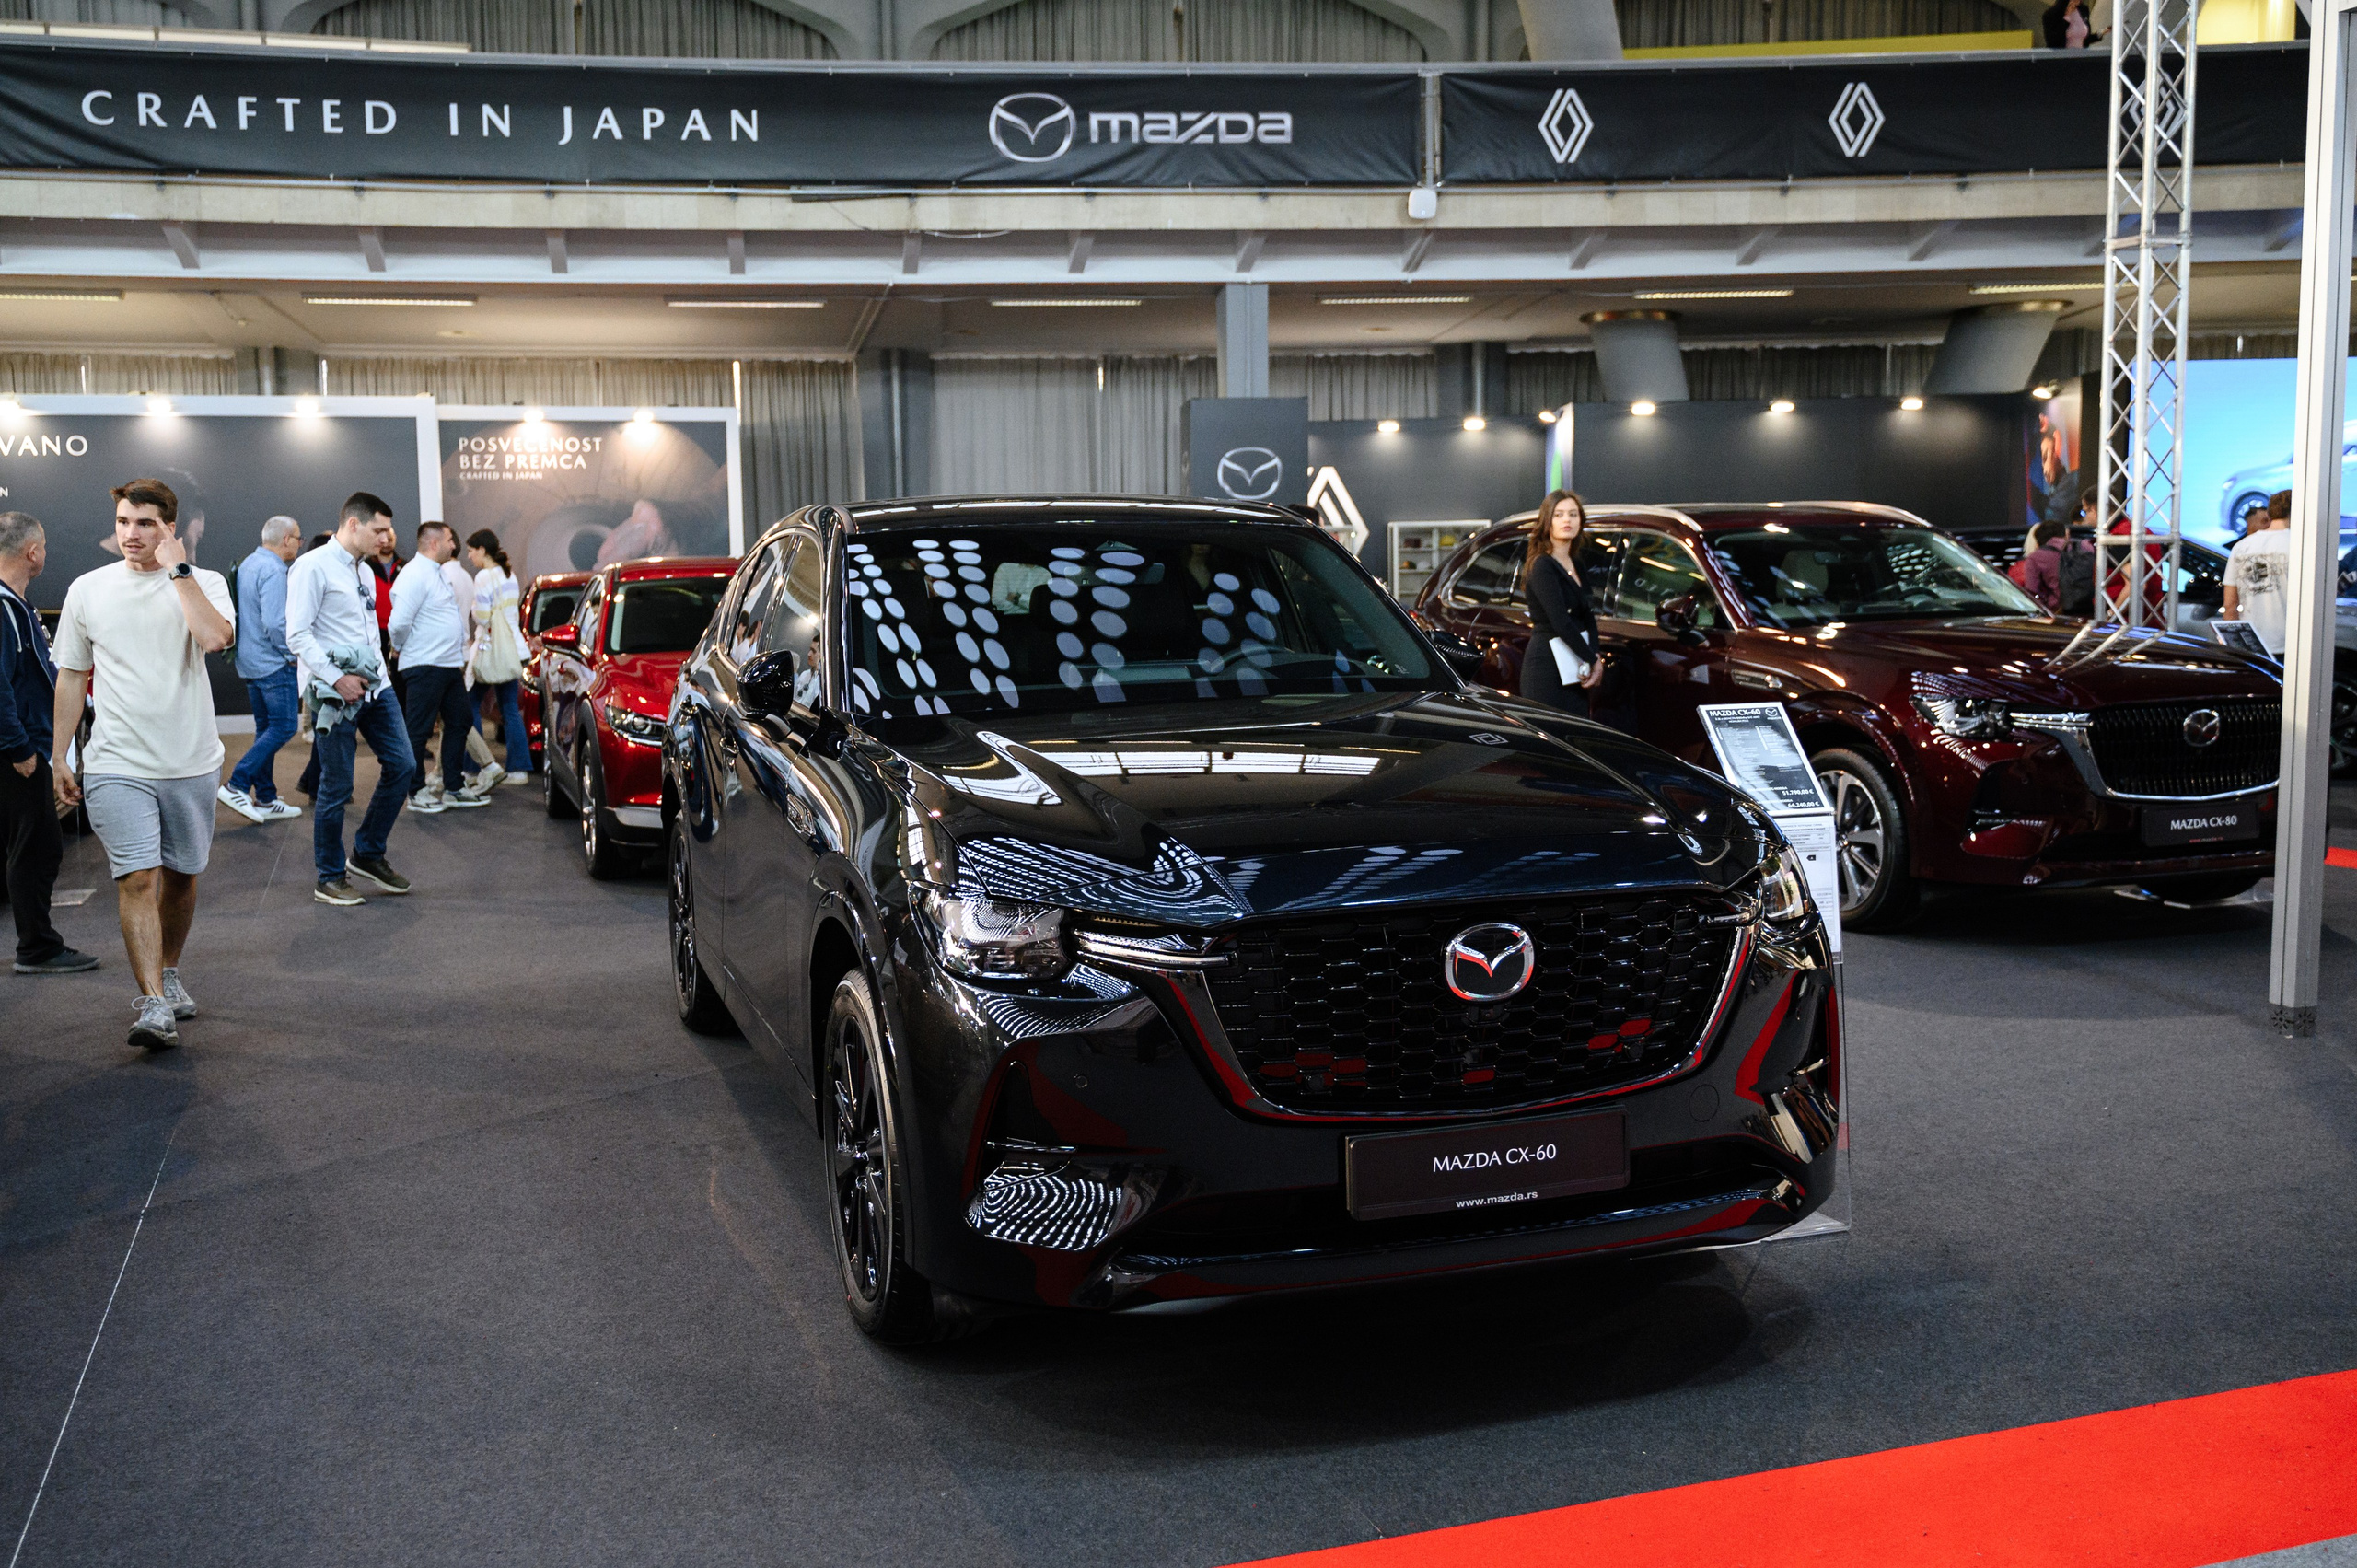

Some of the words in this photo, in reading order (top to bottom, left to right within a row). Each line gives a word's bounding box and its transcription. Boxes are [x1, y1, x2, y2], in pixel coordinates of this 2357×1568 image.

[81, 90, 398, 134] CRAFTED
[448, 102, 511, 138] IN
[557, 105, 759, 145] JAPAN
[0, 435, 88, 457] VANO
[459, 454, 497, 470] BEZ
[505, 454, 587, 470] PREMCA
[459, 471, 500, 481] CRAFTED
[502, 471, 513, 481] IN
[515, 470, 543, 482] JAPAN
[1709, 709, 1737, 717] MAZDA
[1737, 708, 1761, 716] CX-60
[2170, 818, 2208, 830] MAZDA
[2209, 815, 2237, 828] CX-80
[1433, 1151, 1502, 1172] MAZDA
[1505, 1144, 1557, 1164] CX-60
[1456, 1191, 1538, 1208] www.mazda.rs
